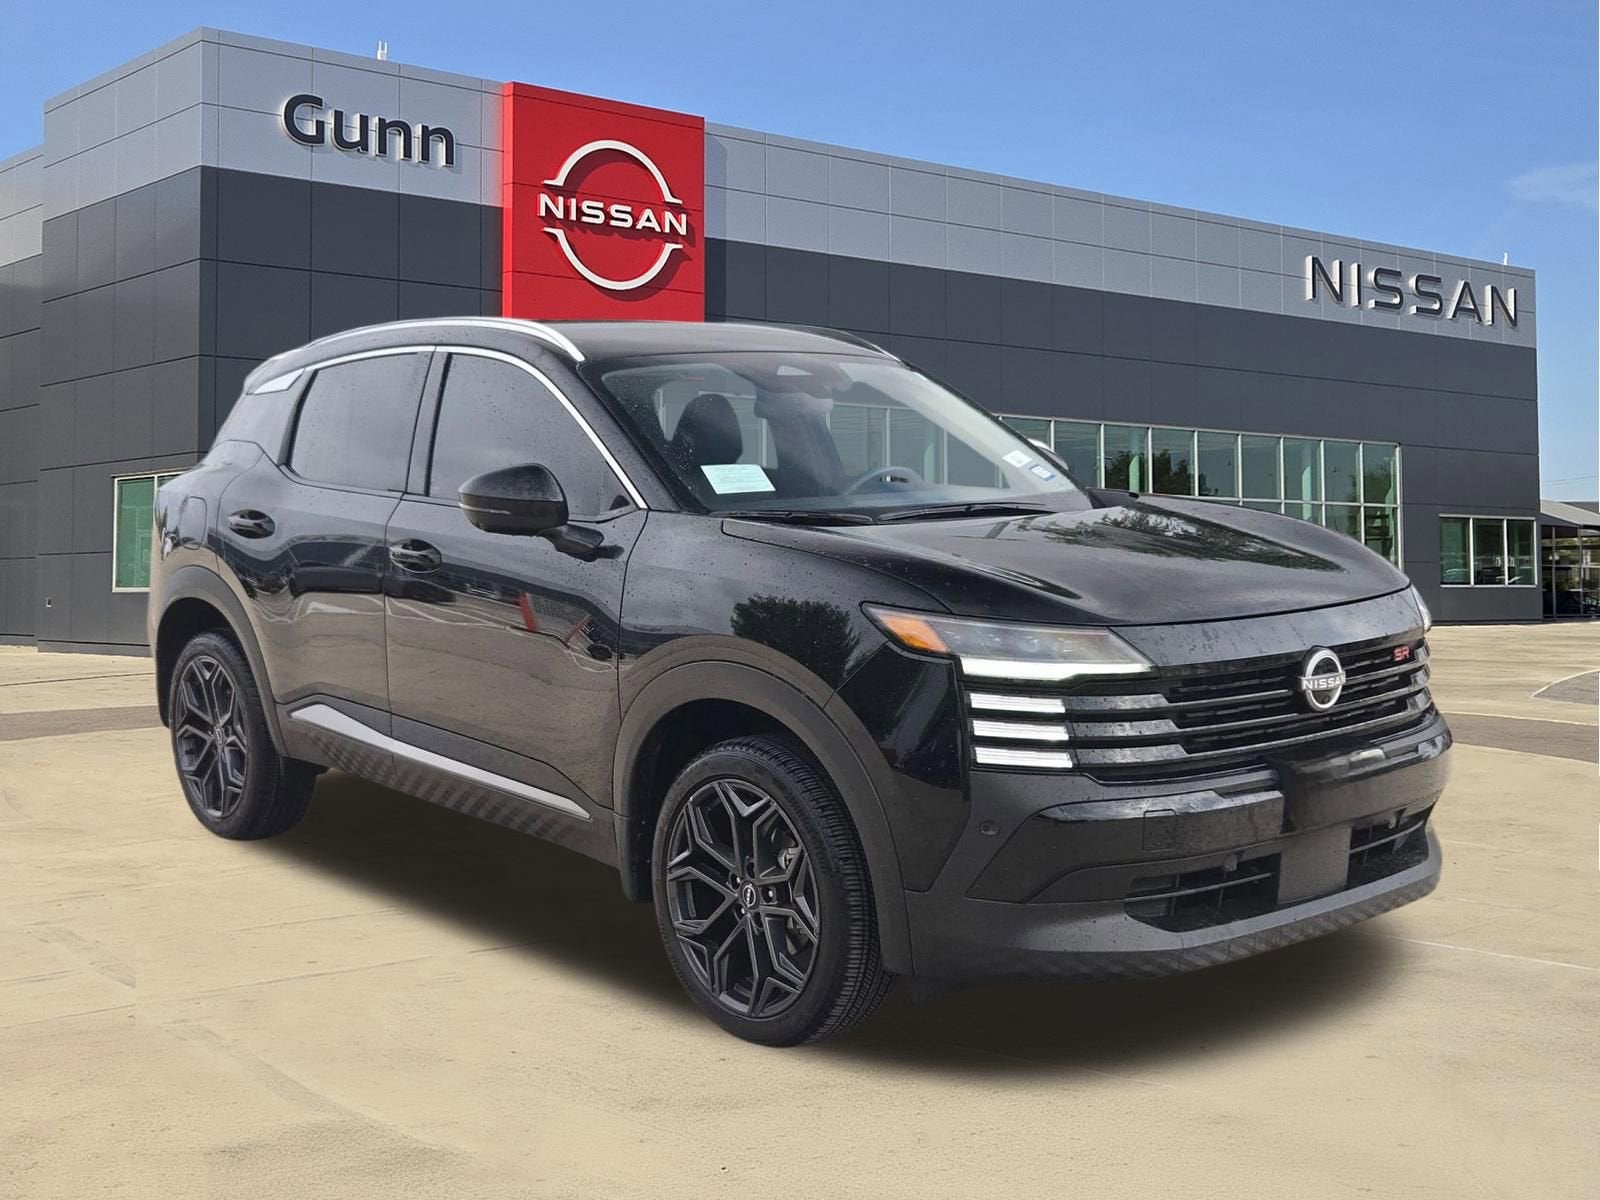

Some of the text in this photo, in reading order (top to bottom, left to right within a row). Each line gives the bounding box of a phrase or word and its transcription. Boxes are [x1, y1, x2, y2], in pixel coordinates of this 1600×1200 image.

[282, 93, 455, 166] Gunn
[537, 193, 687, 236] NISSAN
[1305, 255, 1518, 328] NISSAN
[1394, 646, 1409, 661] SR
